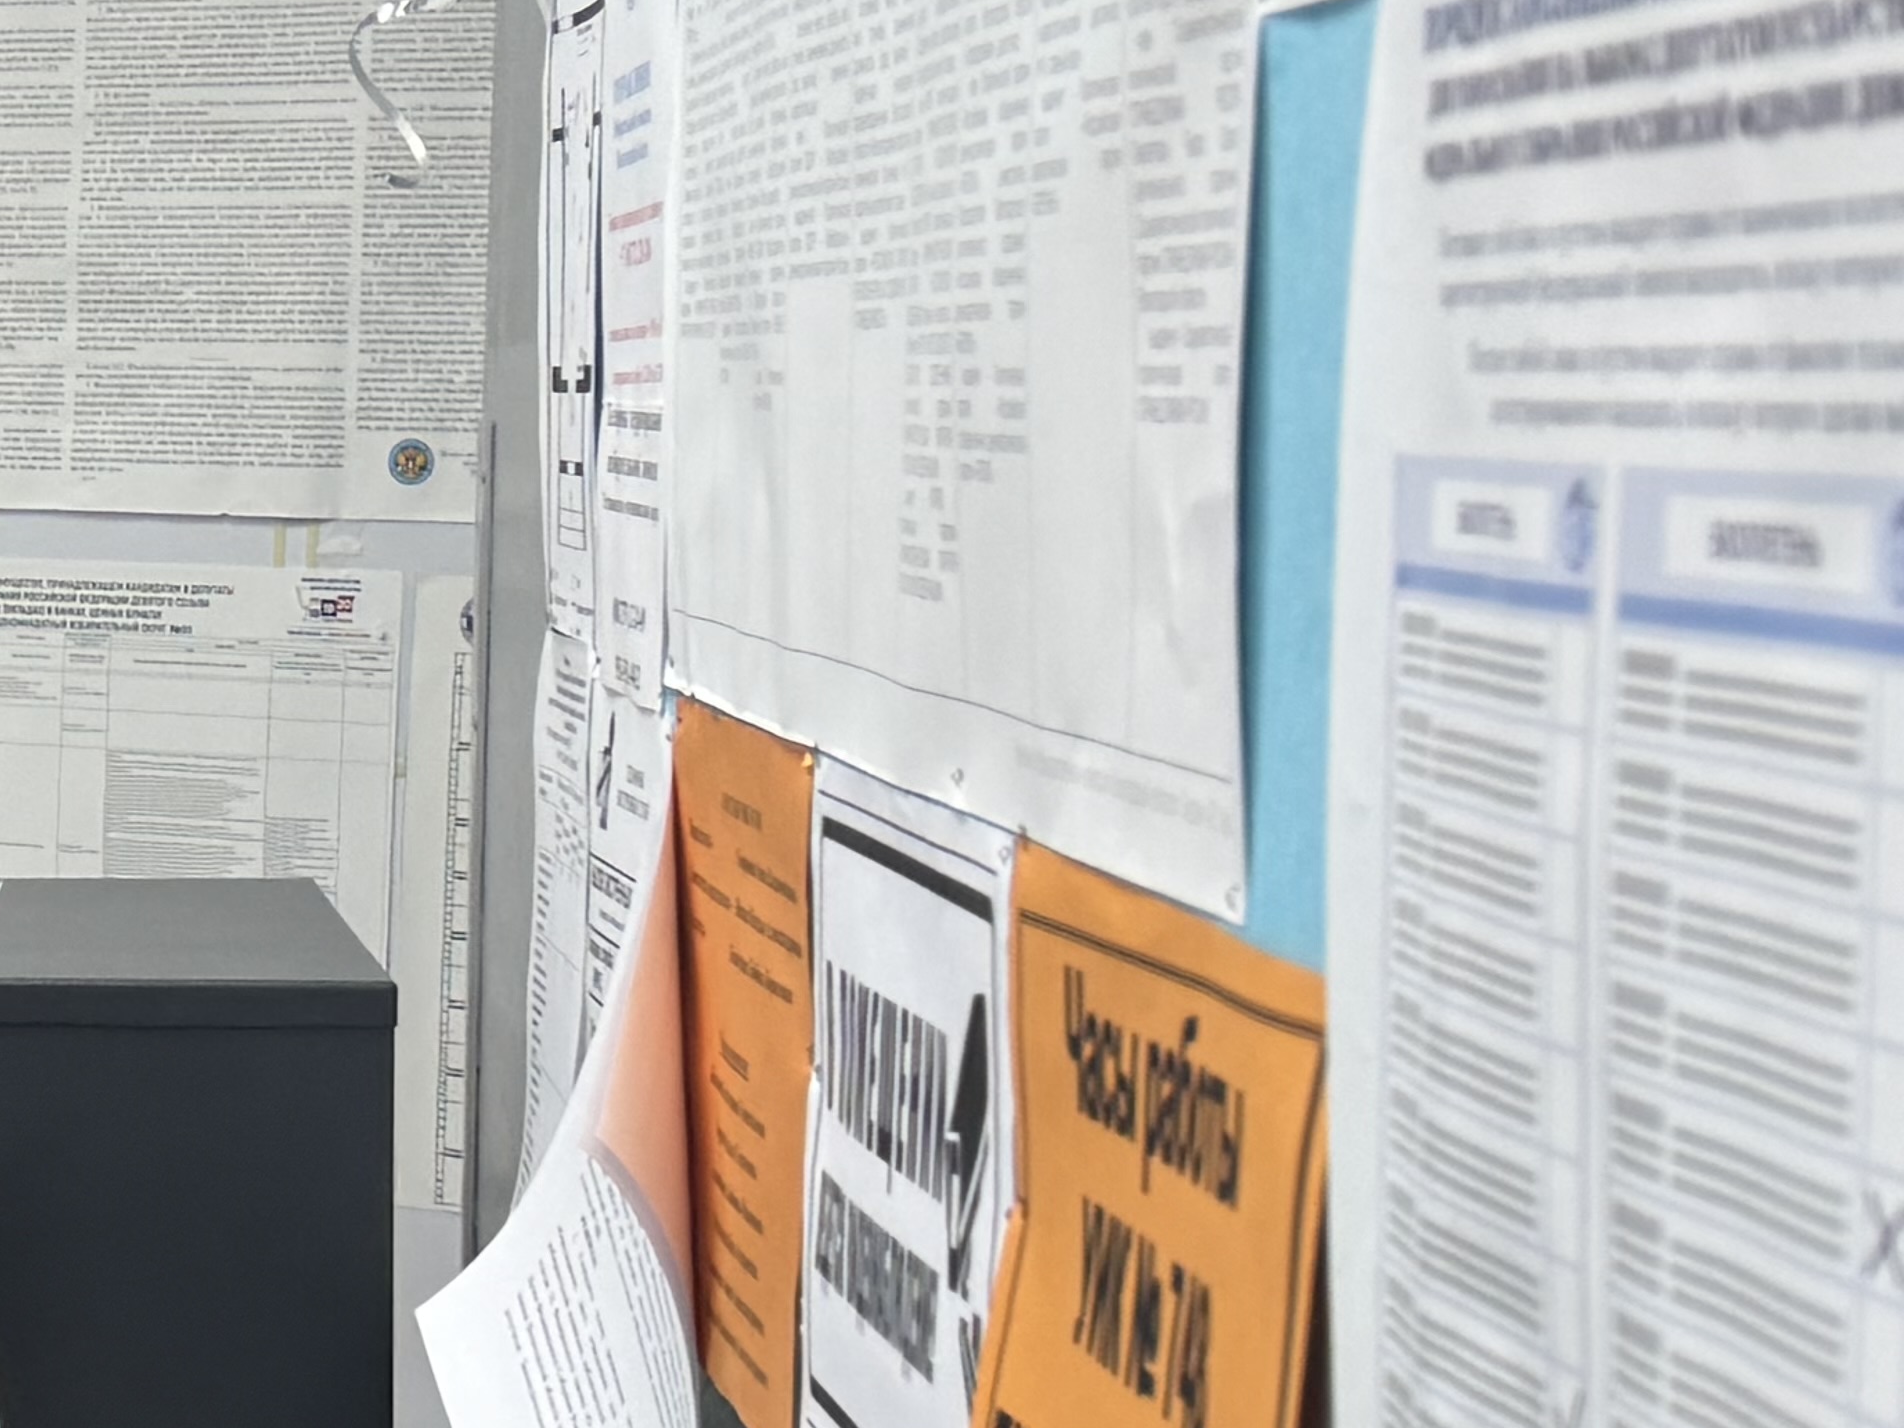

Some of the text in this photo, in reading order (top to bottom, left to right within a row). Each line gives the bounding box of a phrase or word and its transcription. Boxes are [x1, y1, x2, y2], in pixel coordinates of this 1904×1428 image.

[1063, 964, 1245, 1213] Часы работы
[1073, 1195, 1133, 1375] УИК
